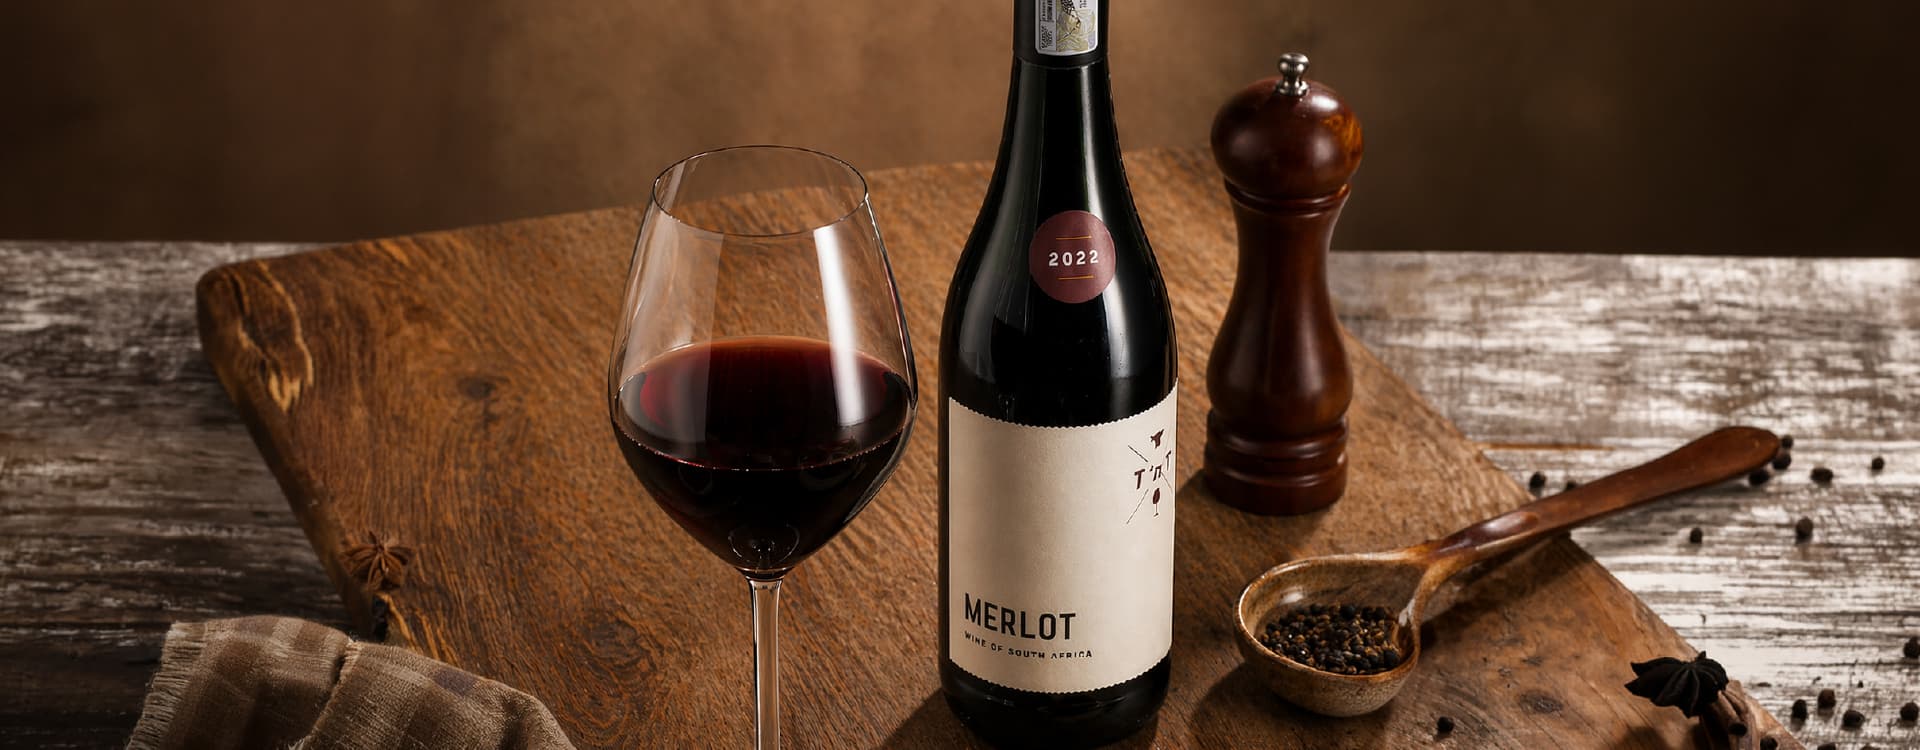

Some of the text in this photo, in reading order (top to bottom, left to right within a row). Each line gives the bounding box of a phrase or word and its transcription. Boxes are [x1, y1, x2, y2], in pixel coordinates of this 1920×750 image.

[1048, 249, 1099, 267] 2022
[964, 592, 1076, 640] MERLOT
[964, 631, 1093, 660] WINE OF SOUTH AFRICA
